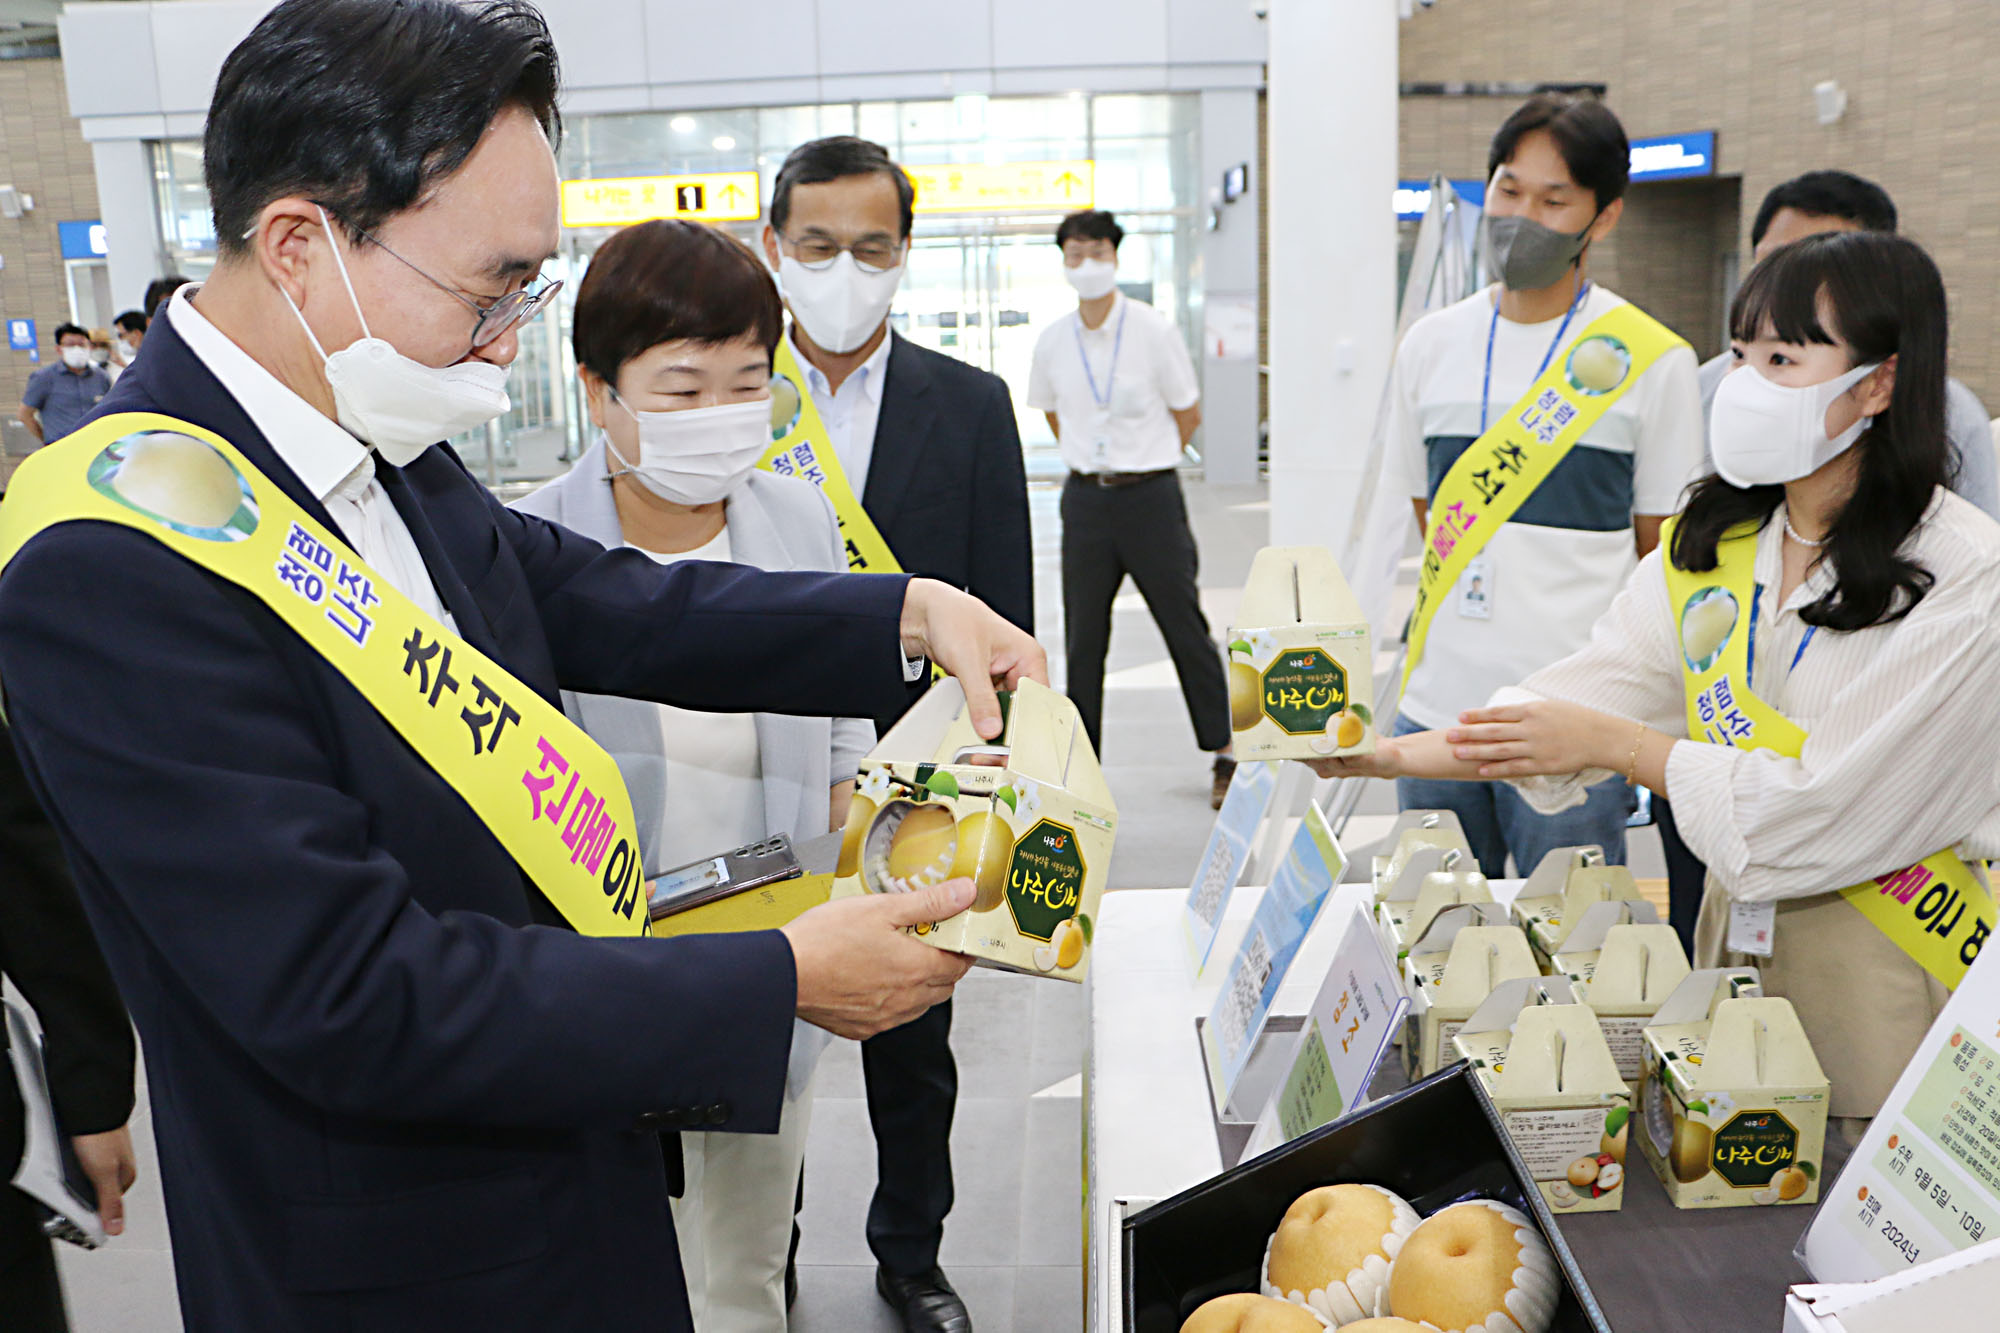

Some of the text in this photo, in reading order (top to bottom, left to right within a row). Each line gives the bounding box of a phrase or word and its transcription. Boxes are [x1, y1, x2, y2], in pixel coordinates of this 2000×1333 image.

[684, 186, 697, 211] 1
[1519, 406, 1556, 443] 나주
[1538, 389, 1577, 426] 청렴
[1472, 440, 1528, 505] 추석
[278, 525, 333, 601] 청렴
[328, 563, 381, 645] 나주
[1266, 686, 1345, 711] 나주배
[1697, 675, 1733, 722] 청렴
[402, 627, 641, 919] 추석 선물은
[974, 775, 995, 785] 나주시
[1012, 868, 1078, 910] 나주배
[1716, 1145, 1792, 1166] 나주배
[1888, 1156, 1906, 1176] 시기
[1898, 1144, 1914, 1163] 수확
[1858, 1208, 1875, 1228] 시기
[1866, 1194, 1882, 1215] 판매
[1914, 1167, 1933, 1192] 9월
[1930, 1183, 1951, 1209] 5일
[1959, 1211, 1986, 1242] 10일
[1881, 1220, 1920, 1264] 2024년
